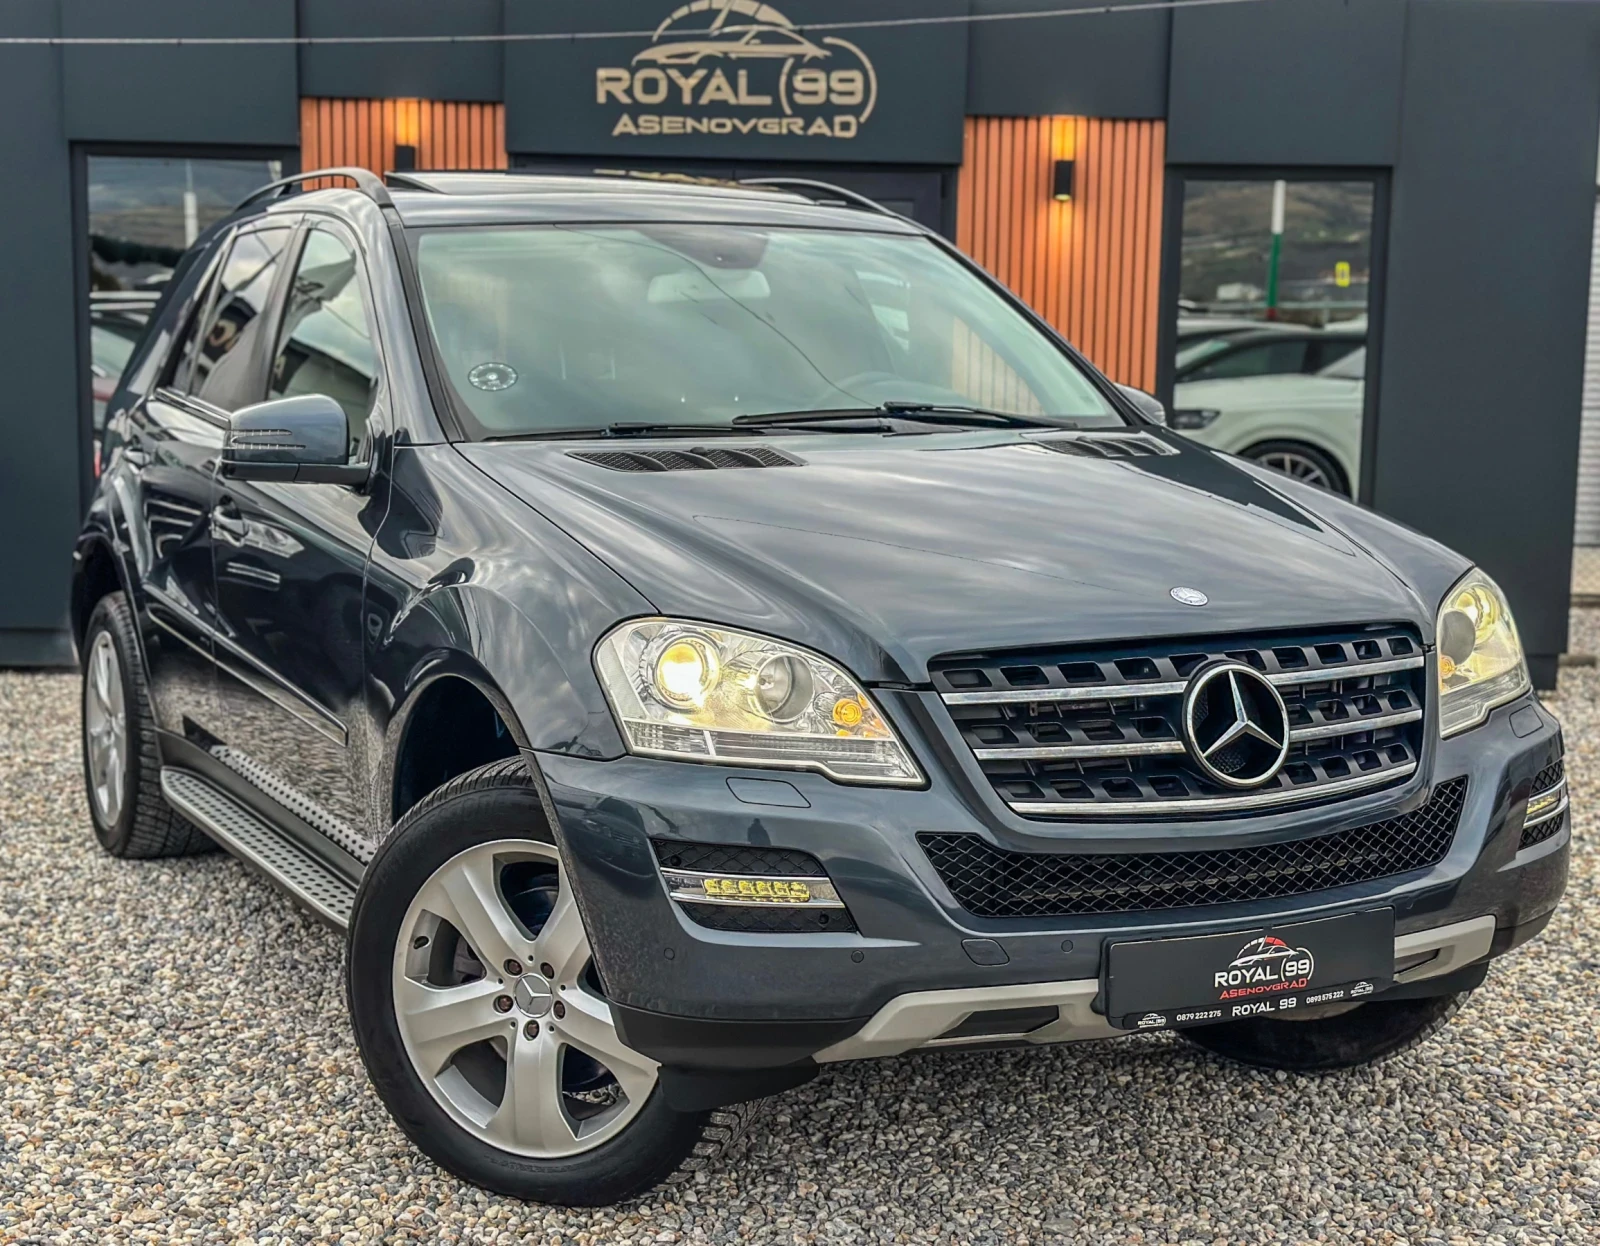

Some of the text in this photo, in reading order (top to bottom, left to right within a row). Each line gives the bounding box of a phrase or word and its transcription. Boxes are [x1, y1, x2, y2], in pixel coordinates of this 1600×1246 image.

[596, 67, 772, 105] ROYAL
[612, 113, 857, 138] ASENOVGRAD
[1214, 965, 1278, 988] ROYAL
[1219, 978, 1307, 999] ASENOVGRAD
[1306, 995, 1321, 1004] 0893
[1333, 990, 1344, 999] 222
[1176, 1010, 1222, 1021] 0879 222 275
[1232, 997, 1297, 1017] ROYAL 99
